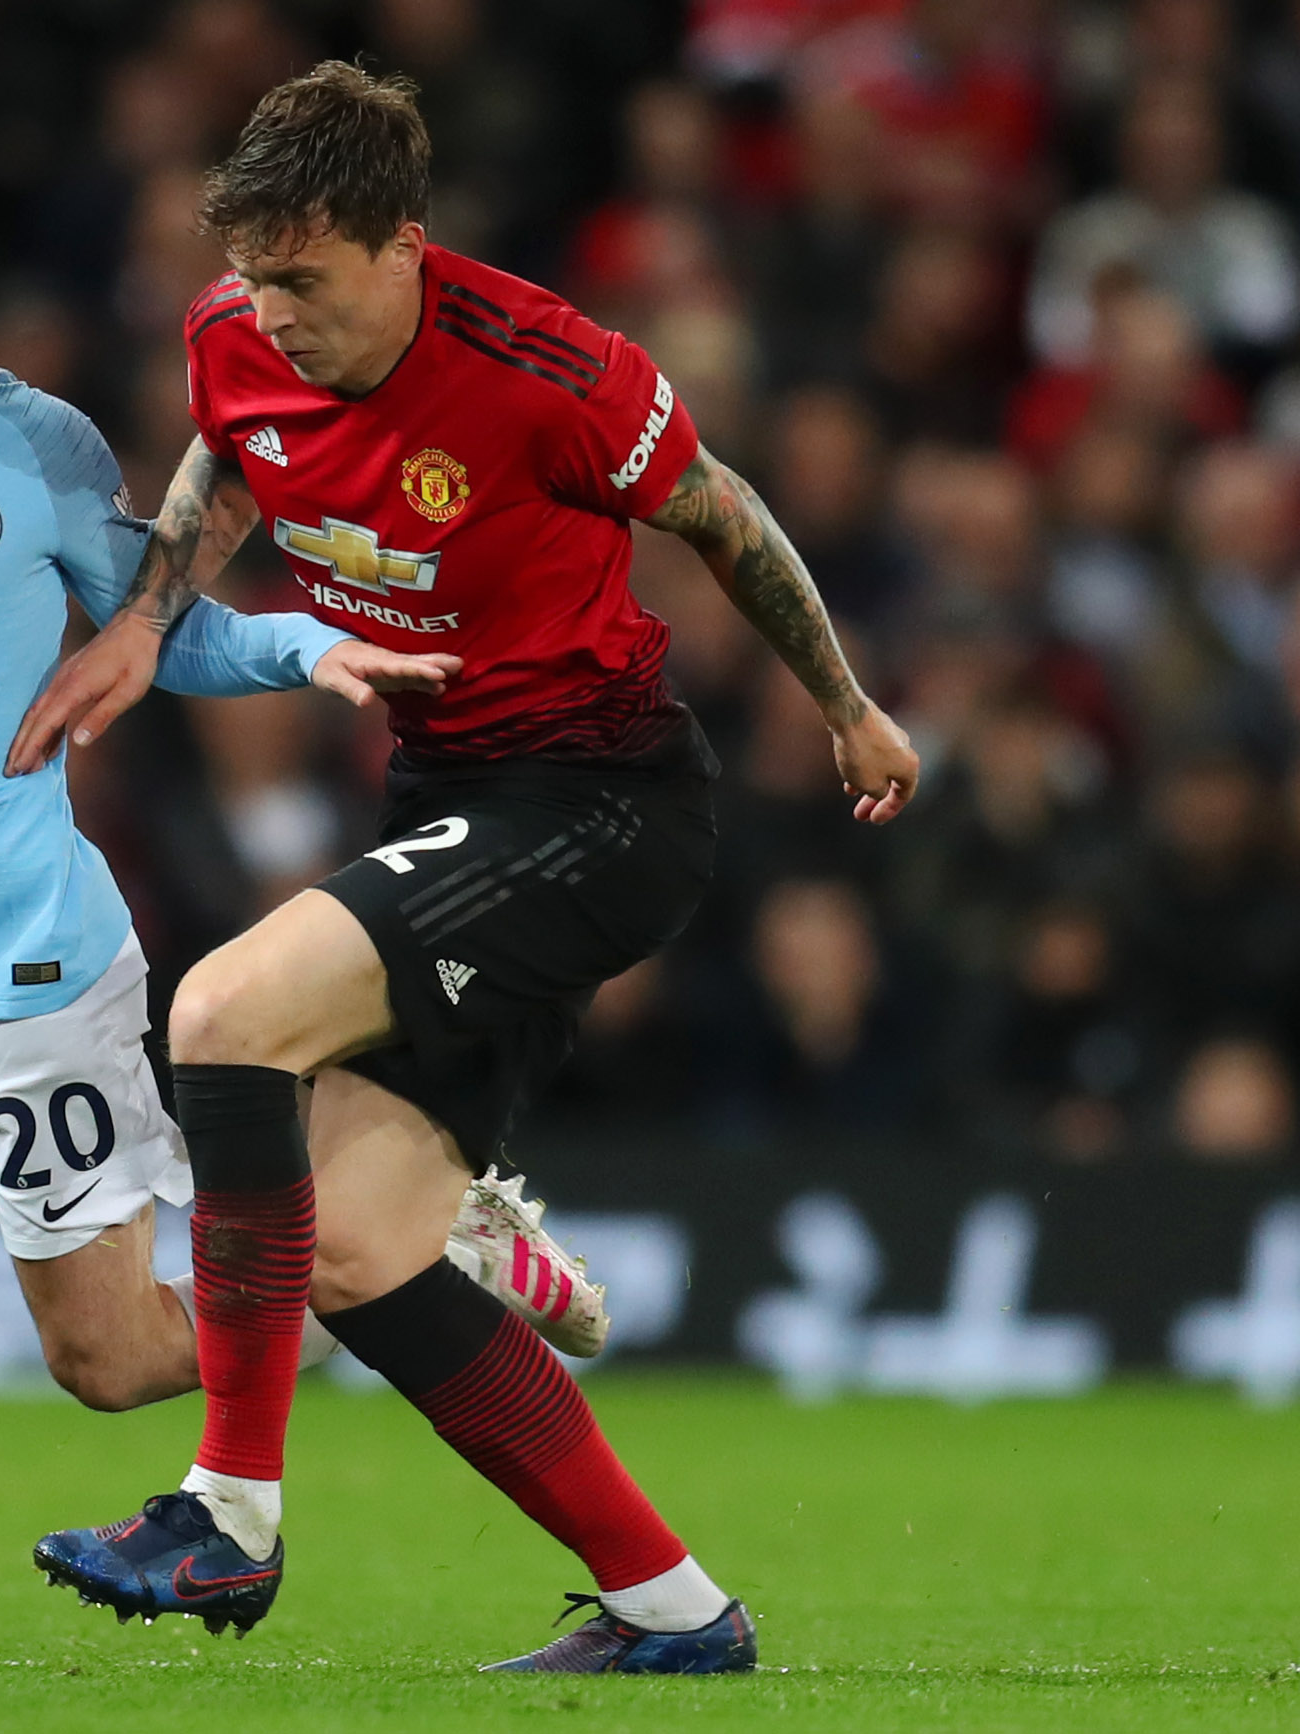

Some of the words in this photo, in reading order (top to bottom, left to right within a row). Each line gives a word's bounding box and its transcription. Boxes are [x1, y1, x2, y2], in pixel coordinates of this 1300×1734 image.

[245, 440, 288, 467] adidas
[407, 453, 462, 480] MANCHESTER
[418, 503, 457, 518] UNITED
[363, 816, 469, 875] 2
[436, 959, 460, 1005] adidas
